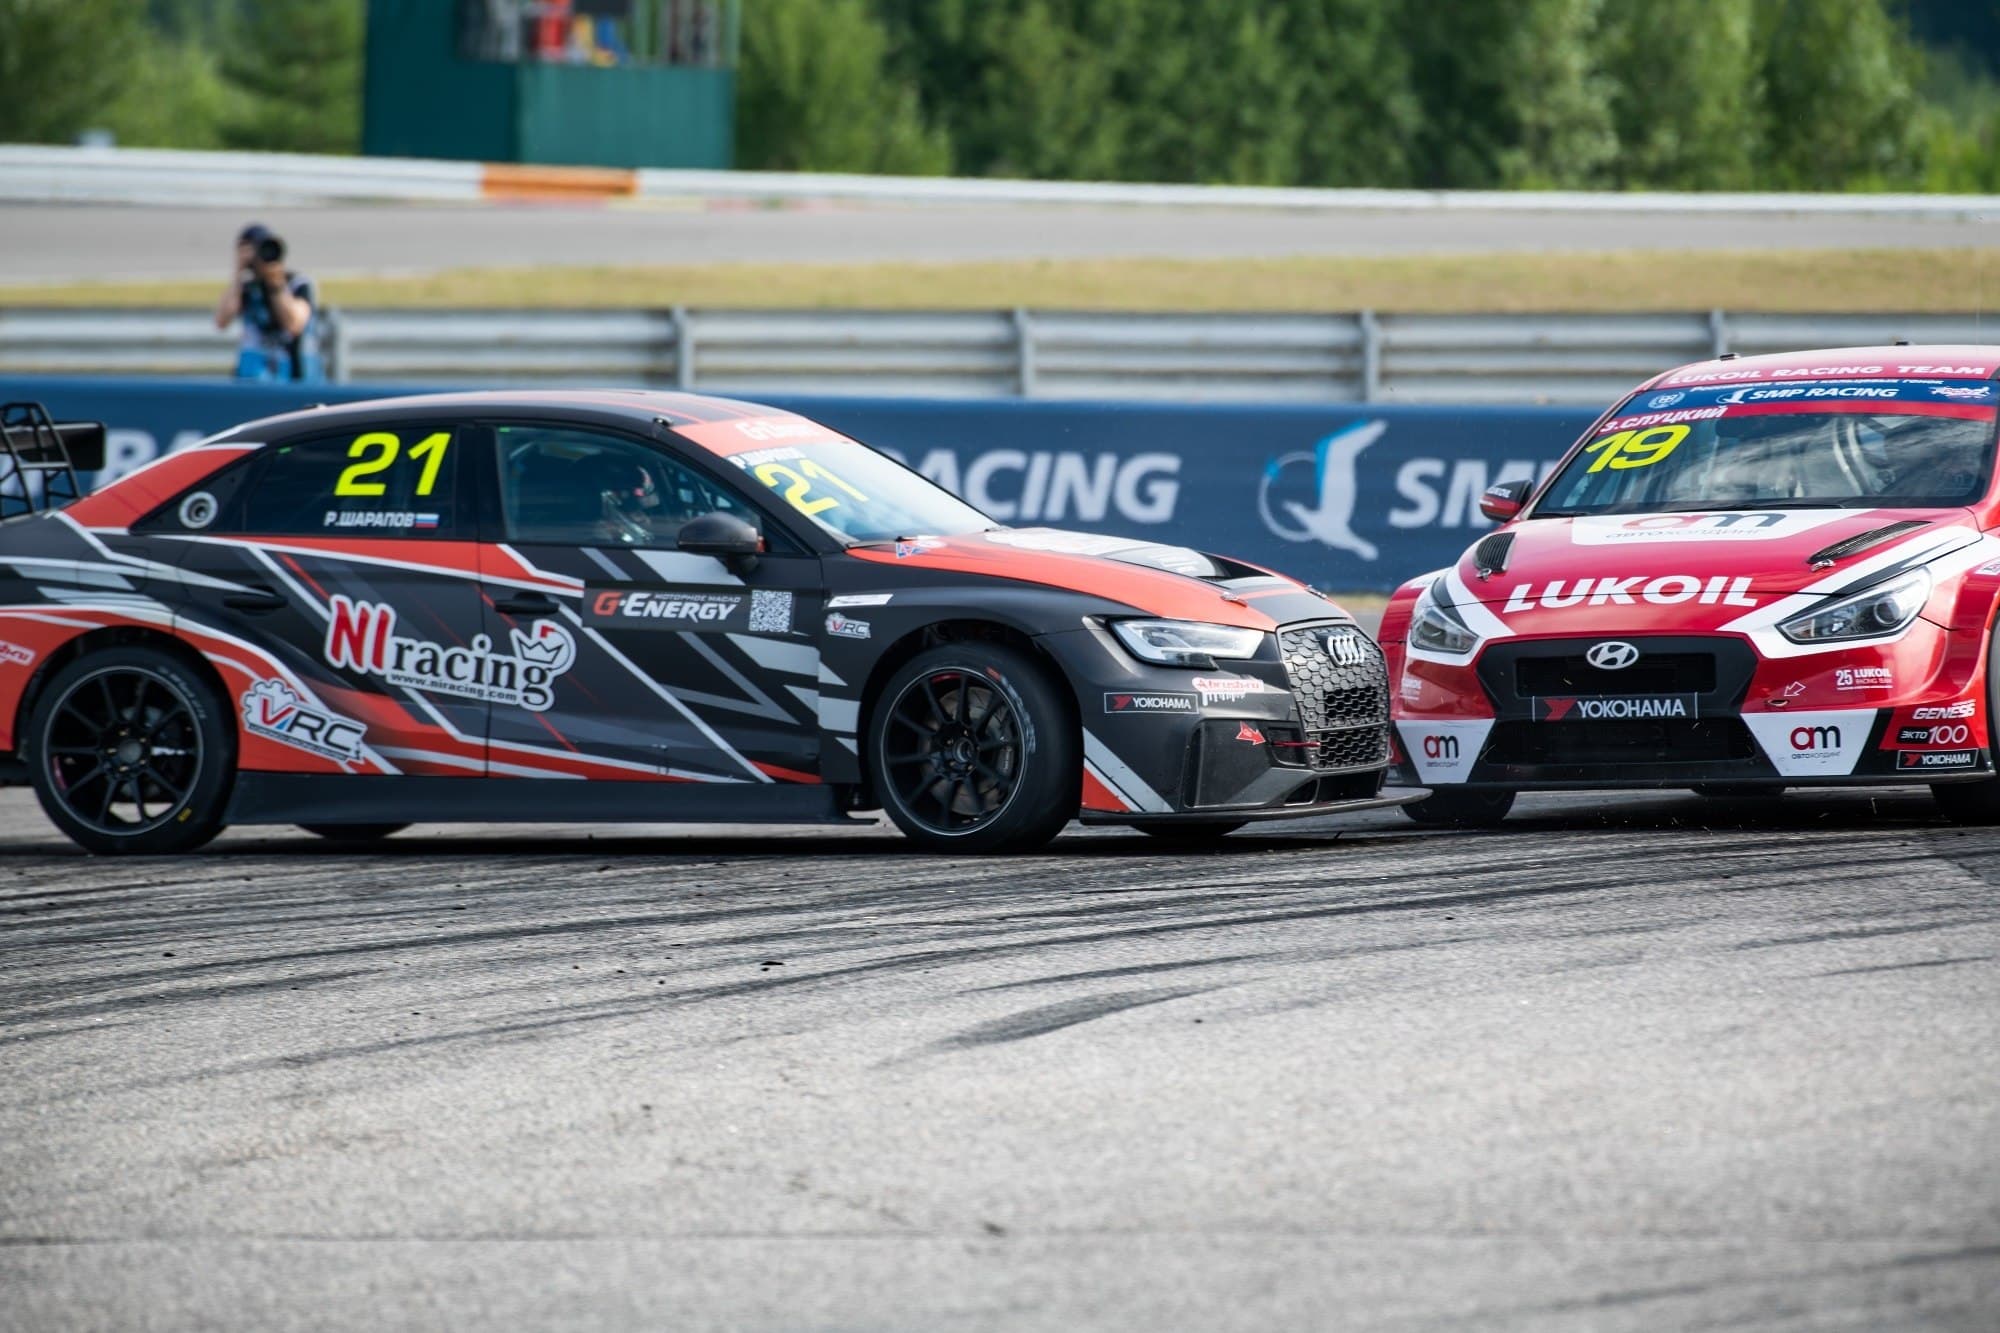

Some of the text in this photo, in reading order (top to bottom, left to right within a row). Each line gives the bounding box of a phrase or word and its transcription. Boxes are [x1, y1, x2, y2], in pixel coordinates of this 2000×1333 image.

[1667, 365, 1986, 384] LUKOIL RACING TEAM
[1749, 388, 1807, 400] SMP
[1803, 386, 1900, 398] RACING
[1585, 424, 1691, 473] 19
[333, 432, 451, 496] 21
[754, 458, 870, 516] 21
[880, 448, 1182, 524] ACING
[1389, 457, 1562, 528] SM
[323, 510, 415, 528] Р.ШАРАПОВ
[1501, 574, 1761, 614] LUKOIL
[831, 620, 870, 636] VRC
[390, 672, 518, 701] www.niracing.com
[1835, 667, 1893, 686] 25 LUKOIL
[1132, 697, 1192, 710] YOKOHAMA
[1576, 698, 1687, 719] YOKOHAMA
[260, 697, 363, 752] VRC
[1921, 752, 1972, 765] YOKOHAMA
